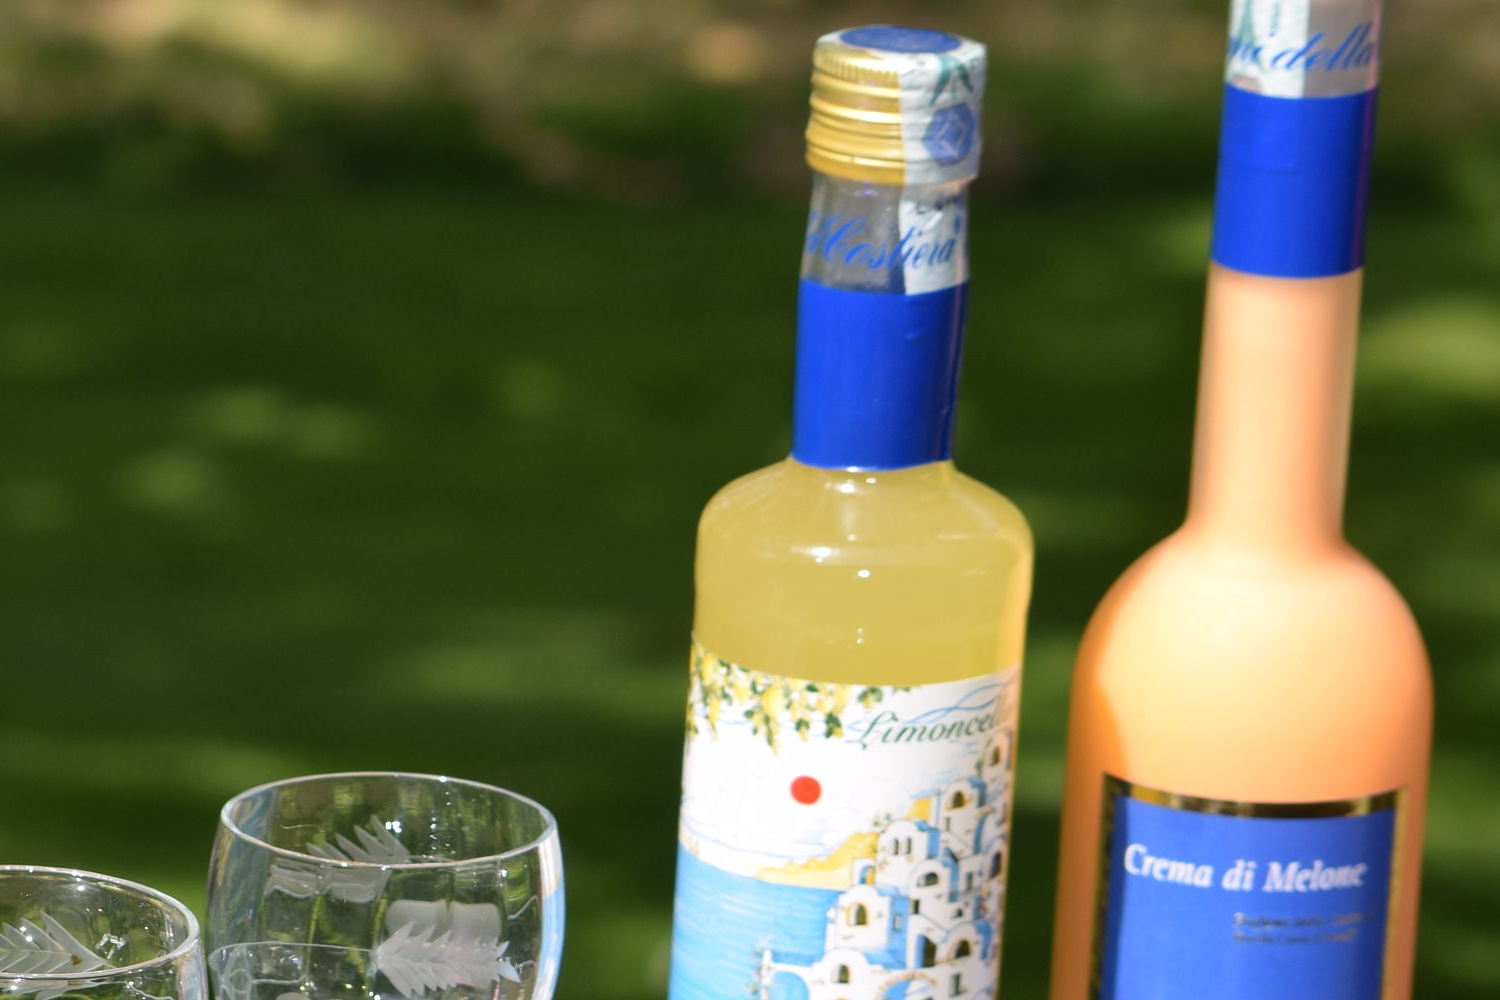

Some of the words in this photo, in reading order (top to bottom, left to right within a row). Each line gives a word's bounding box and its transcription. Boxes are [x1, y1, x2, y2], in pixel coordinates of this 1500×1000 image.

[1124, 843, 1214, 888] Crema
[1222, 859, 1257, 891] di
[1262, 860, 1368, 892] Melone
